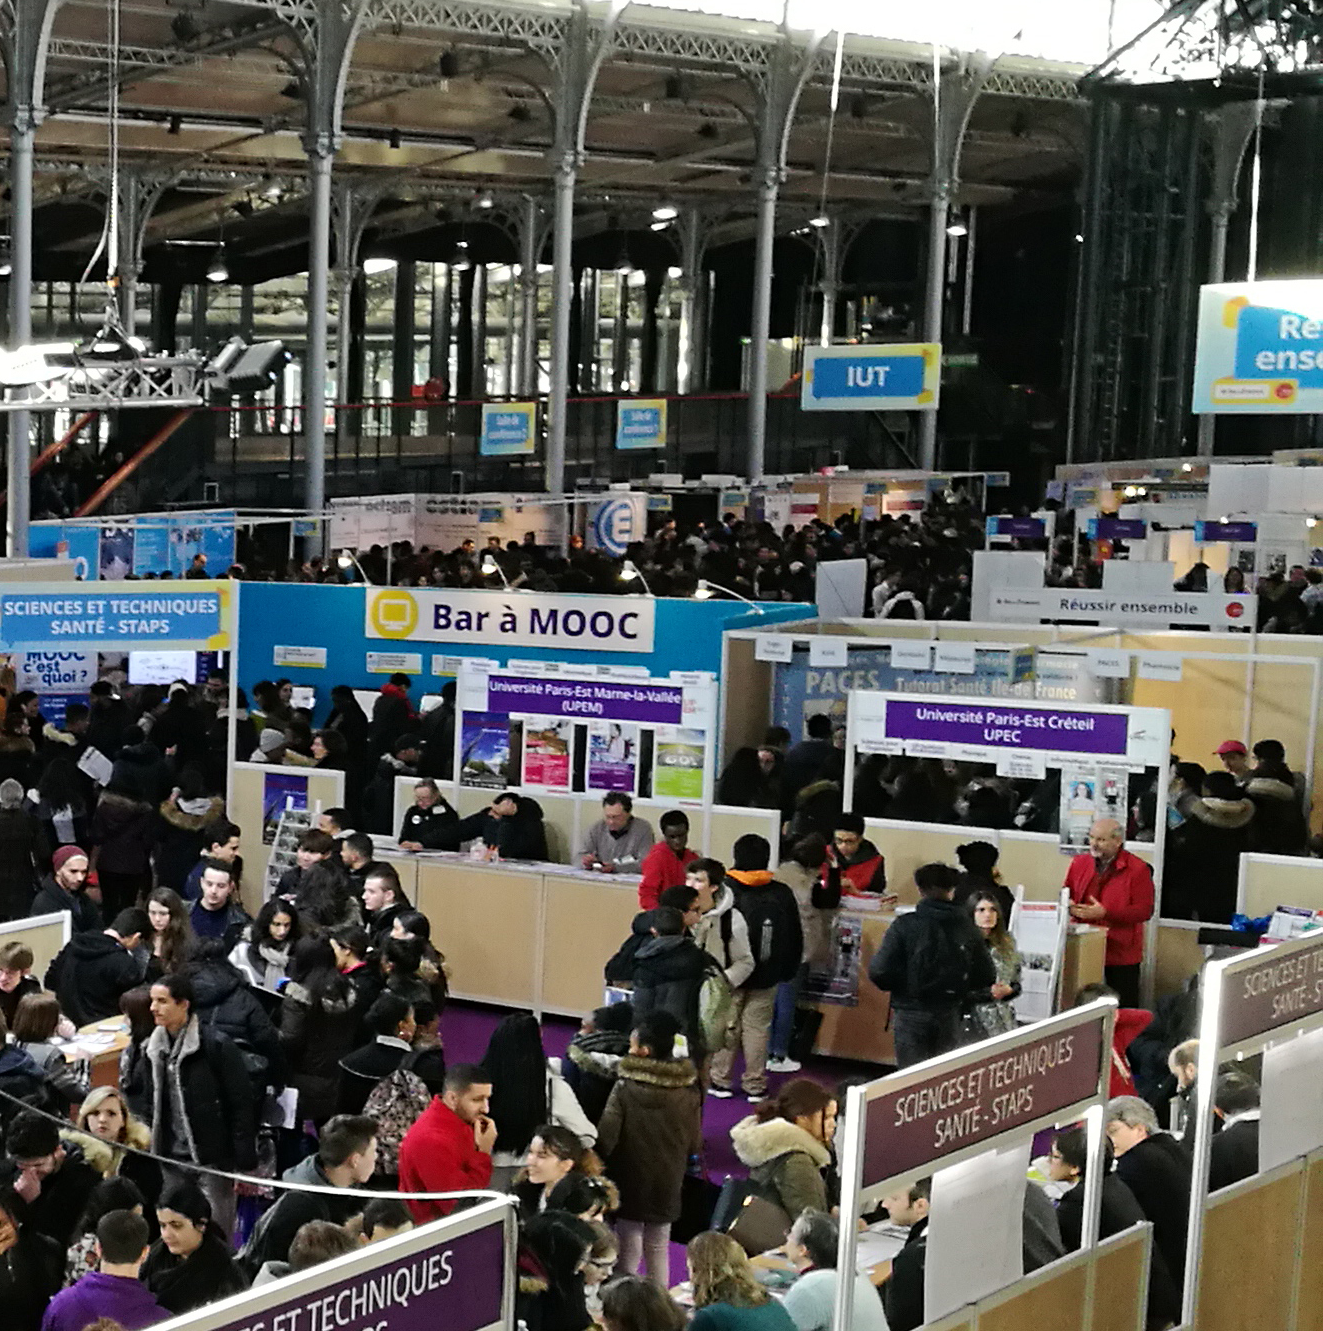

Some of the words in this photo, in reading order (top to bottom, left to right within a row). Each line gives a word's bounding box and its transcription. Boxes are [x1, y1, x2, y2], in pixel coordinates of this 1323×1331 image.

[847, 366, 891, 388] IUT
[4, 601, 83, 616] SCIENCES
[86, 600, 108, 614] ET
[110, 599, 218, 616] TECHNIQUES
[1059, 598, 1116, 612] Réussir
[1121, 602, 1198, 615] ensemble
[51, 617, 105, 635] SANTÉ
[118, 619, 170, 634] STAPS
[433, 603, 489, 631] Bar
[499, 597, 517, 633] à
[530, 608, 638, 639] MOOC
[42, 670, 76, 686] quoi
[806, 670, 880, 695] PACES
[489, 681, 543, 696] Université
[544, 684, 592, 698] Paris-Est
[1035, 681, 1078, 700] France
[561, 701, 604, 715] (UPEM)
[916, 707, 984, 725] Université
[987, 711, 1046, 729] Paris-Est
[1047, 714, 1095, 731] Créteil
[983, 728, 1022, 744] UPEC
[894, 1070, 966, 1127] SCIENCES
[967, 1062, 987, 1097] ET
[986, 1035, 1075, 1092] TECHNIQUES
[934, 1094, 981, 1150] SANTÉ
[991, 1083, 1034, 1126] STAPS
[307, 1249, 455, 1331] TECHNIQUES
